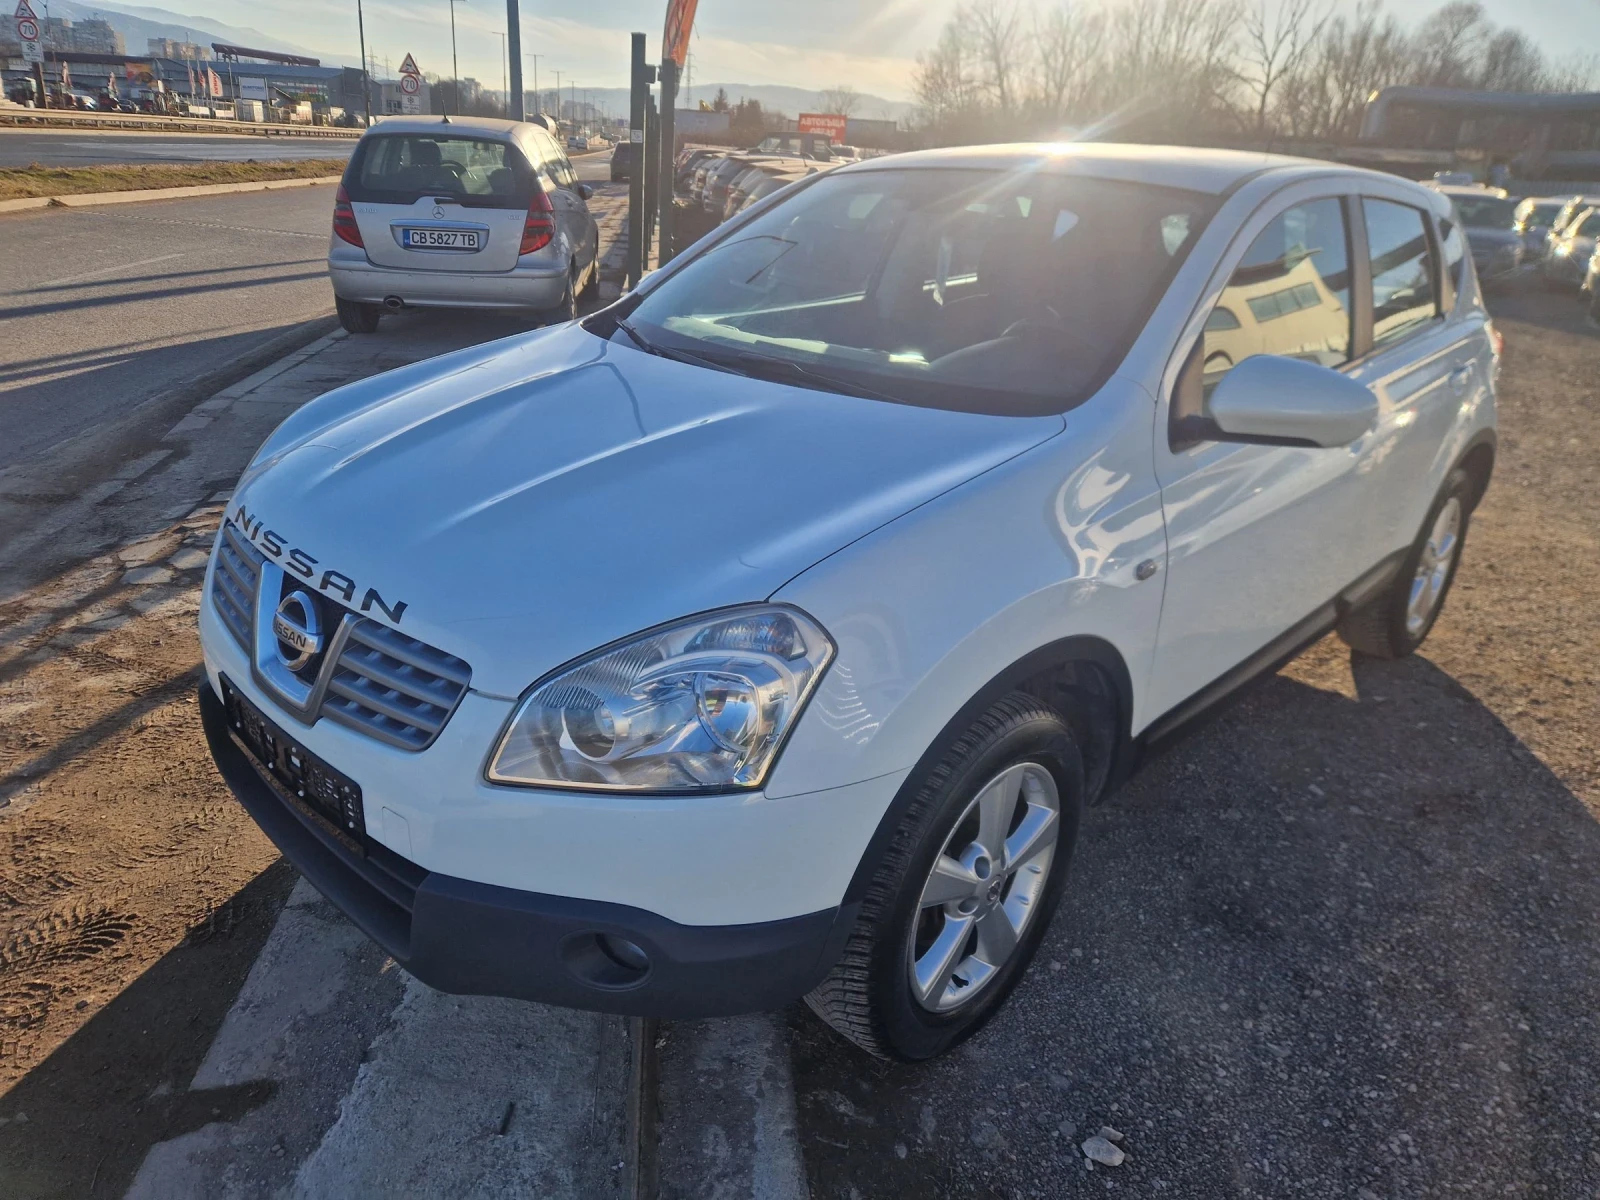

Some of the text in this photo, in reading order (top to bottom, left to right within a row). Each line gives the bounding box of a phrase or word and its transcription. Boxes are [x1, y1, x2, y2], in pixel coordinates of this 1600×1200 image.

[22, 25, 34, 35] 70
[404, 80, 415, 90] 70
[412, 231, 476, 247] CB 5827 TB
[234, 504, 409, 625] NISSAN
